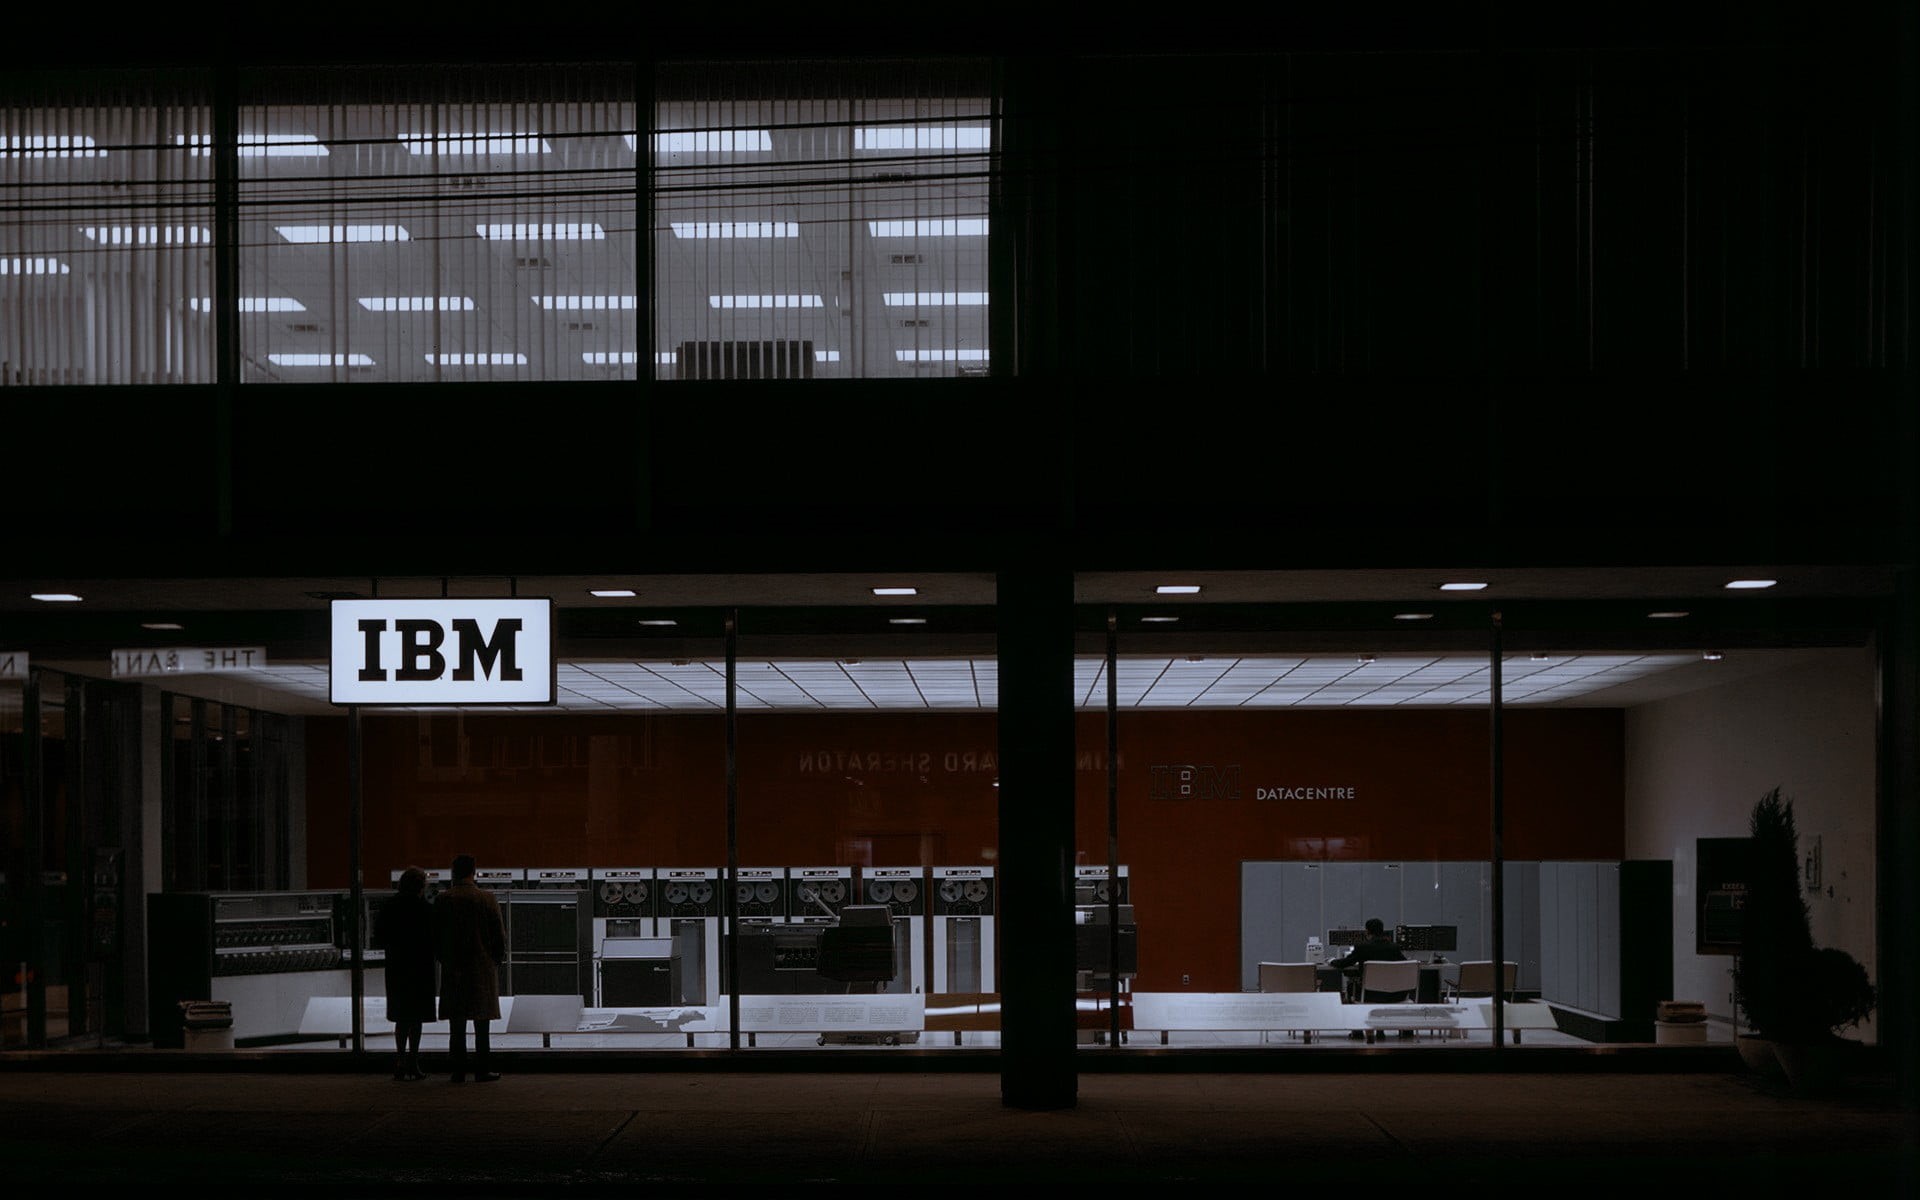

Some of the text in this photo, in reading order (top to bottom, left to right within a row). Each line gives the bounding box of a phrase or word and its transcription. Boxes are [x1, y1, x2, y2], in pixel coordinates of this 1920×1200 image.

[359, 619, 523, 680] IBM
[1151, 765, 1356, 801] IBM DATACENTRE
